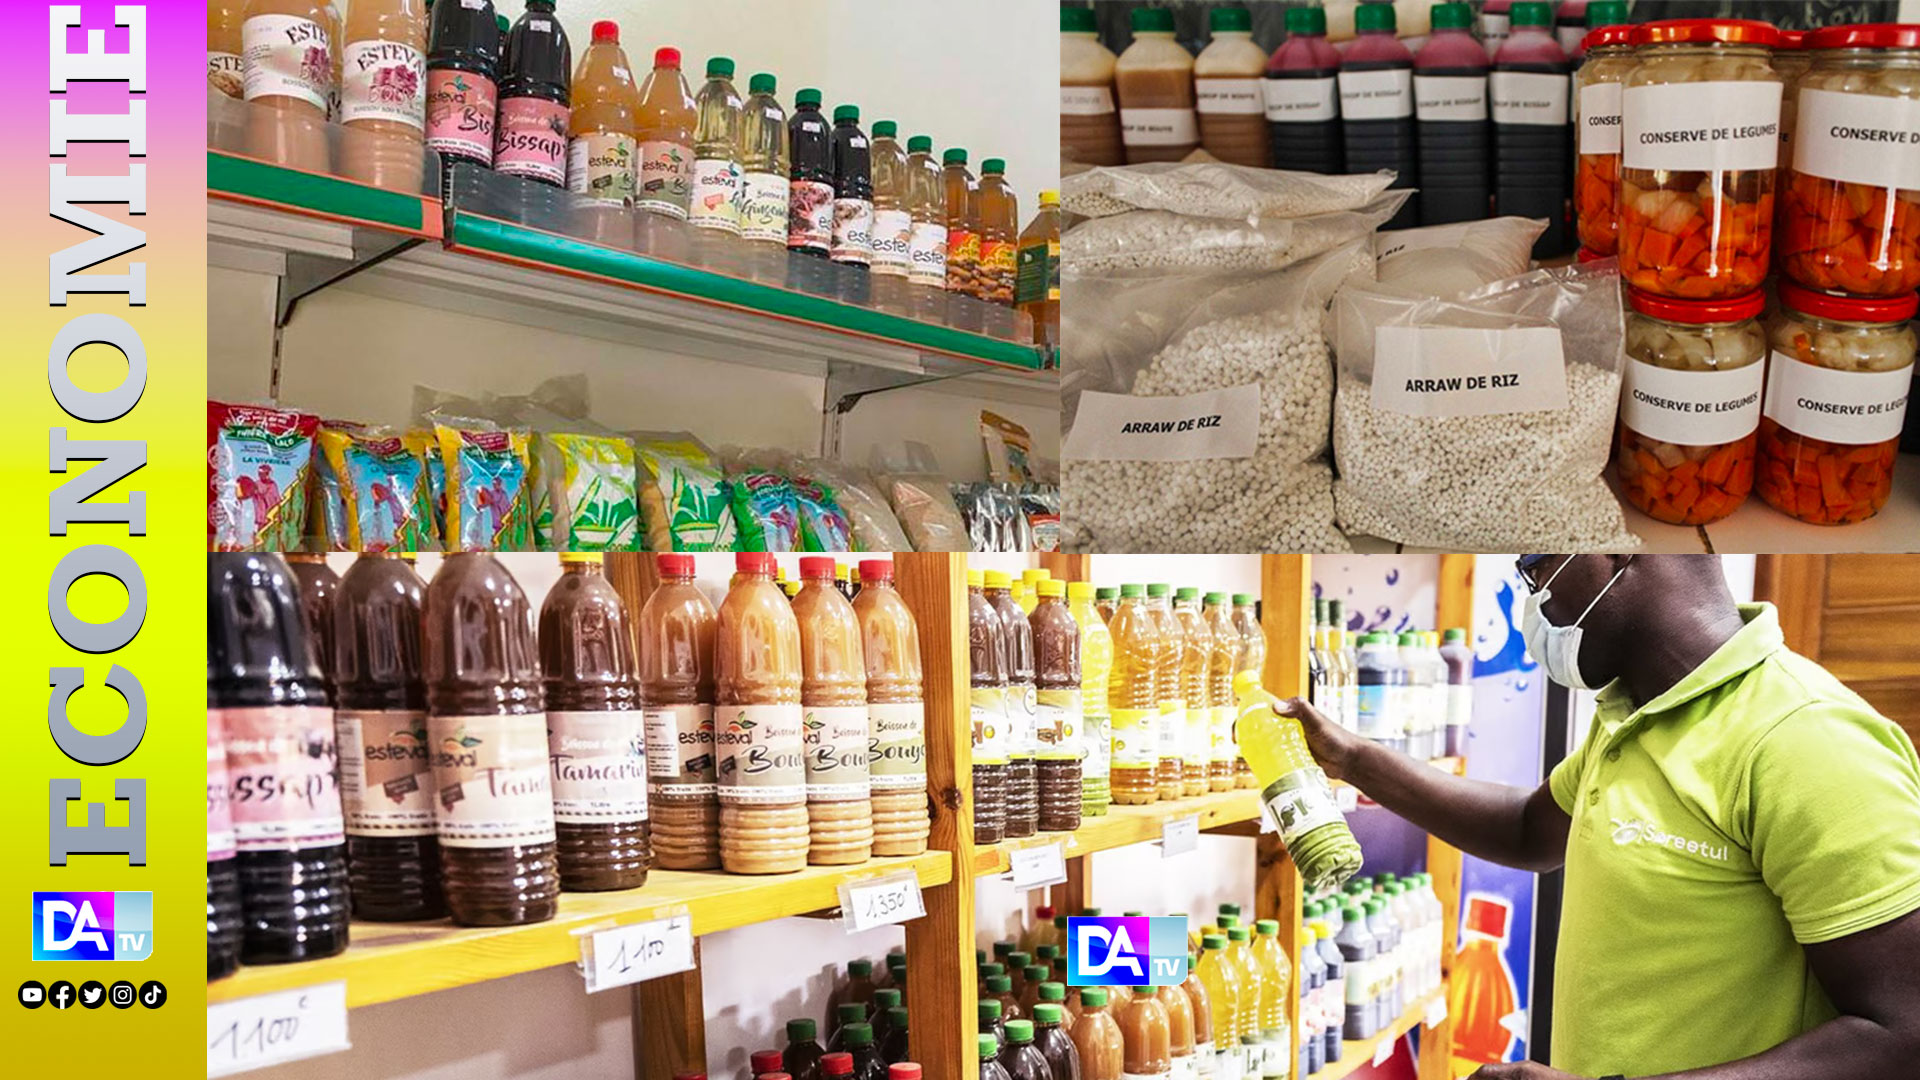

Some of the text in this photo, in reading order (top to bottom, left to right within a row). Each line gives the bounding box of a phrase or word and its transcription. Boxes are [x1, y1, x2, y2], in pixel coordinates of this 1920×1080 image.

[207, 56, 243, 73] STE
[1640, 123, 1777, 144] CONSERVE DE LEGUMES
[1830, 126, 1907, 143] CONSERVE
[1405, 374, 1519, 392] ARRAW DE RIZ
[1633, 389, 1758, 413] CONSERVE DE LEGUMES
[1797, 397, 1864, 415] CONSERVE
[1867, 403, 1882, 414] DE
[1121, 415, 1222, 433] ARRAW DE RIZ
